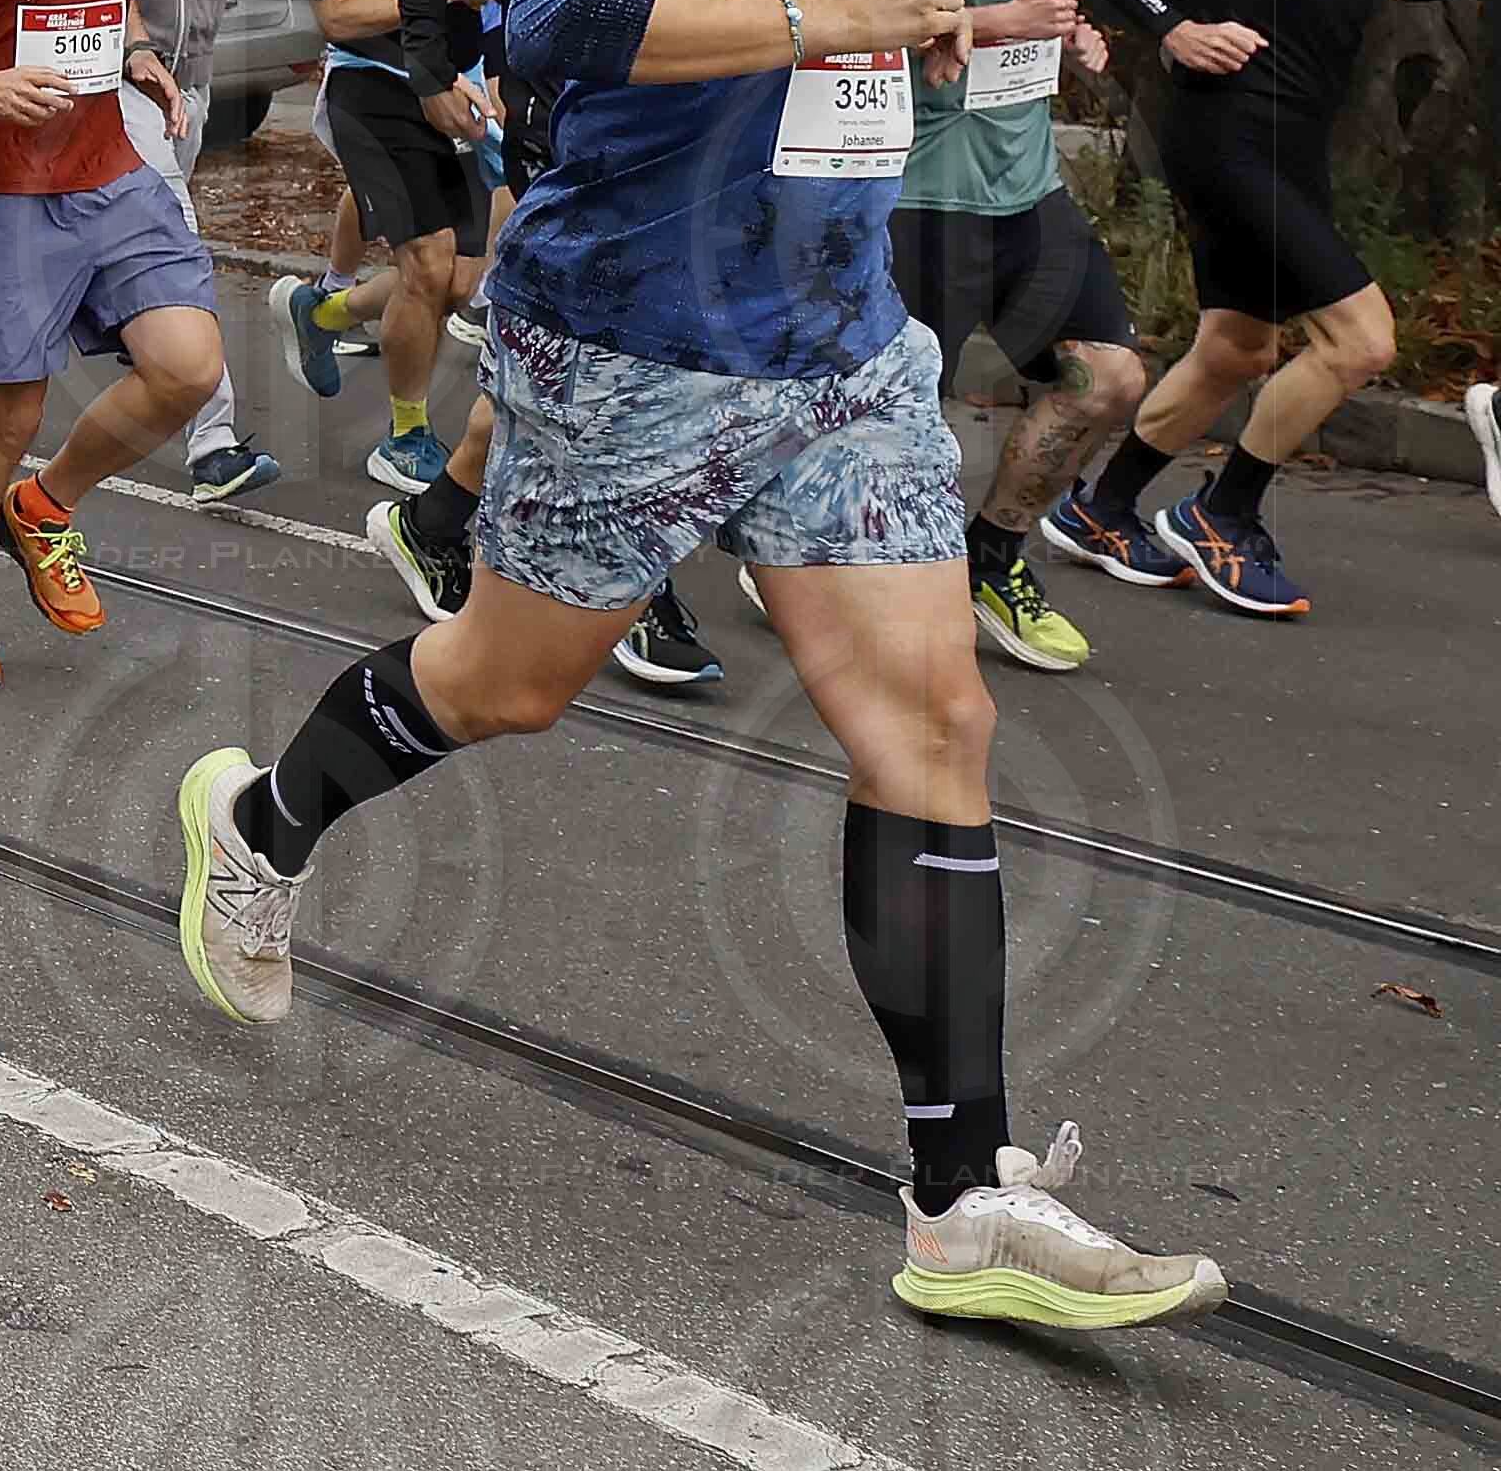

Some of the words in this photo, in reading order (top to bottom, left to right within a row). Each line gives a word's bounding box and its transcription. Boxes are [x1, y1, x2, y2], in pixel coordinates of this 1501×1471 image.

[55, 33, 102, 54] 5106
[1000, 45, 1038, 68] 2895
[835, 78, 889, 110] 3545
[841, 134, 884, 148] Johannes
